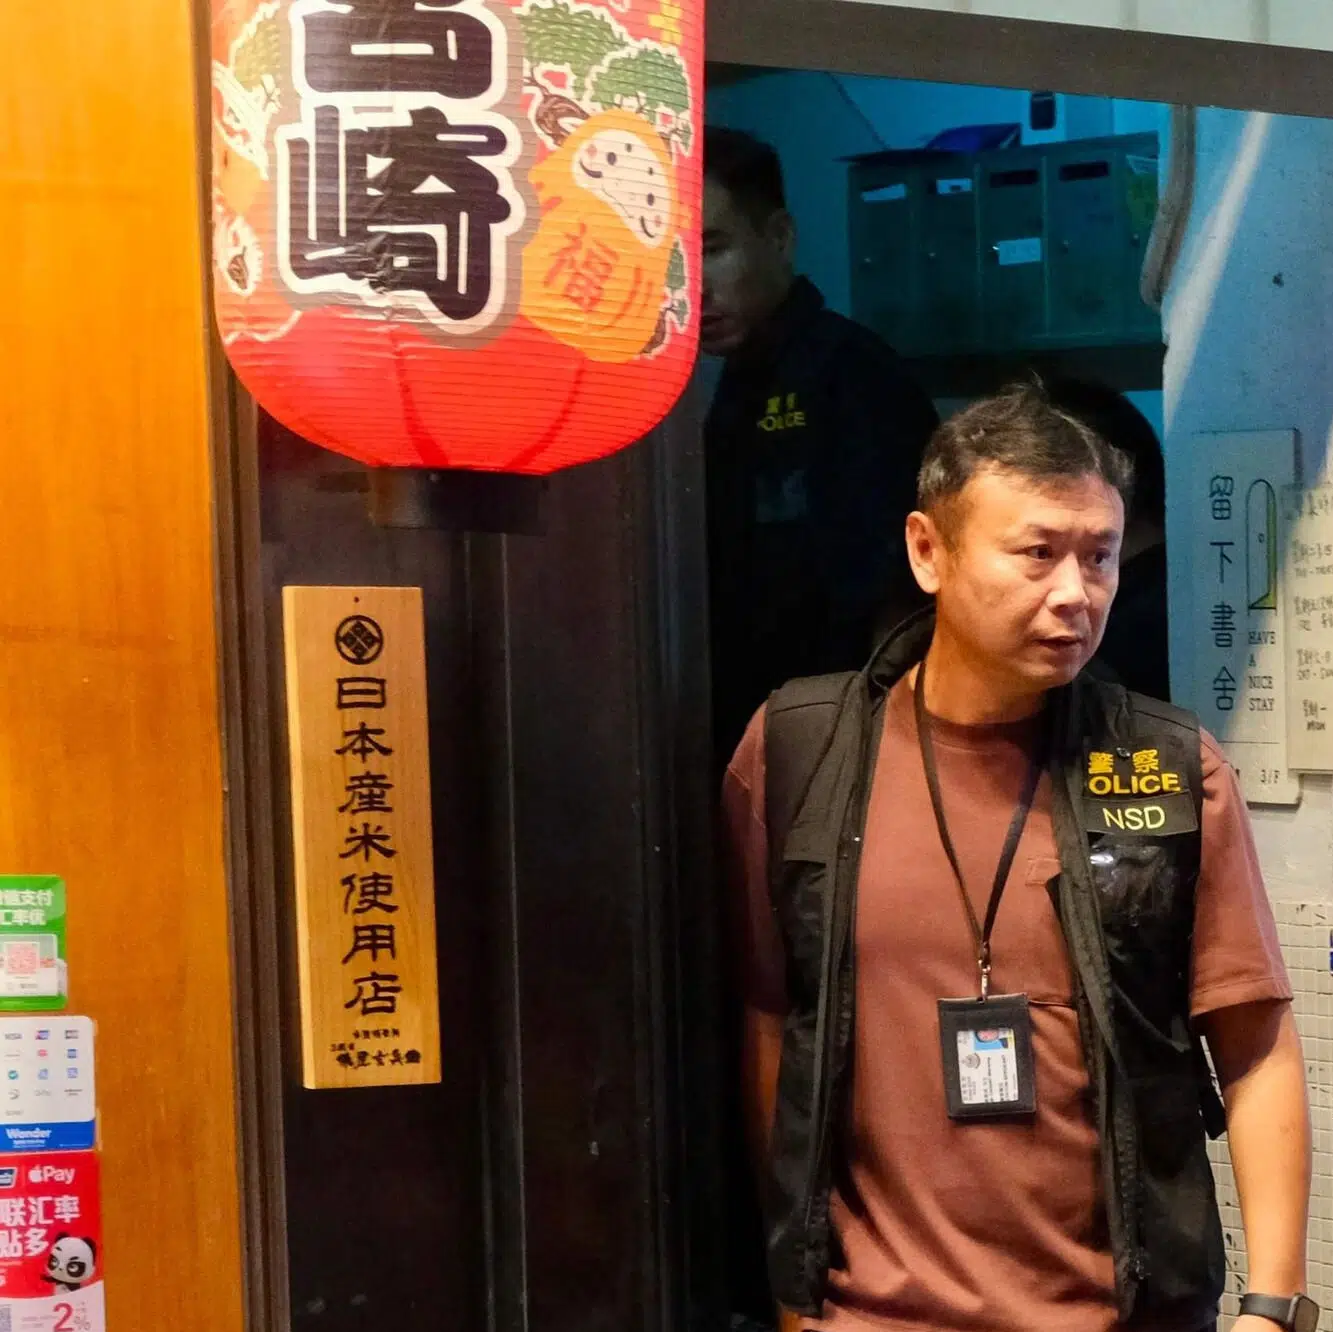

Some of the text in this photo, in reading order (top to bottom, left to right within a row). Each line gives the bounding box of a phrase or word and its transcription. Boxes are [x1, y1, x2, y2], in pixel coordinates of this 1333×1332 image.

[543, 222, 620, 312] 福
[1248, 631, 1276, 645] HAVE
[1249, 653, 1257, 667] A
[1248, 675, 1274, 689] NICE
[1249, 698, 1275, 712] STAY
[1089, 772, 1181, 796] OLICE
[1102, 804, 1166, 831] NSD
[334, 676, 404, 1016] 日本産米使用店
[43, 1165, 76, 1184] Pay
